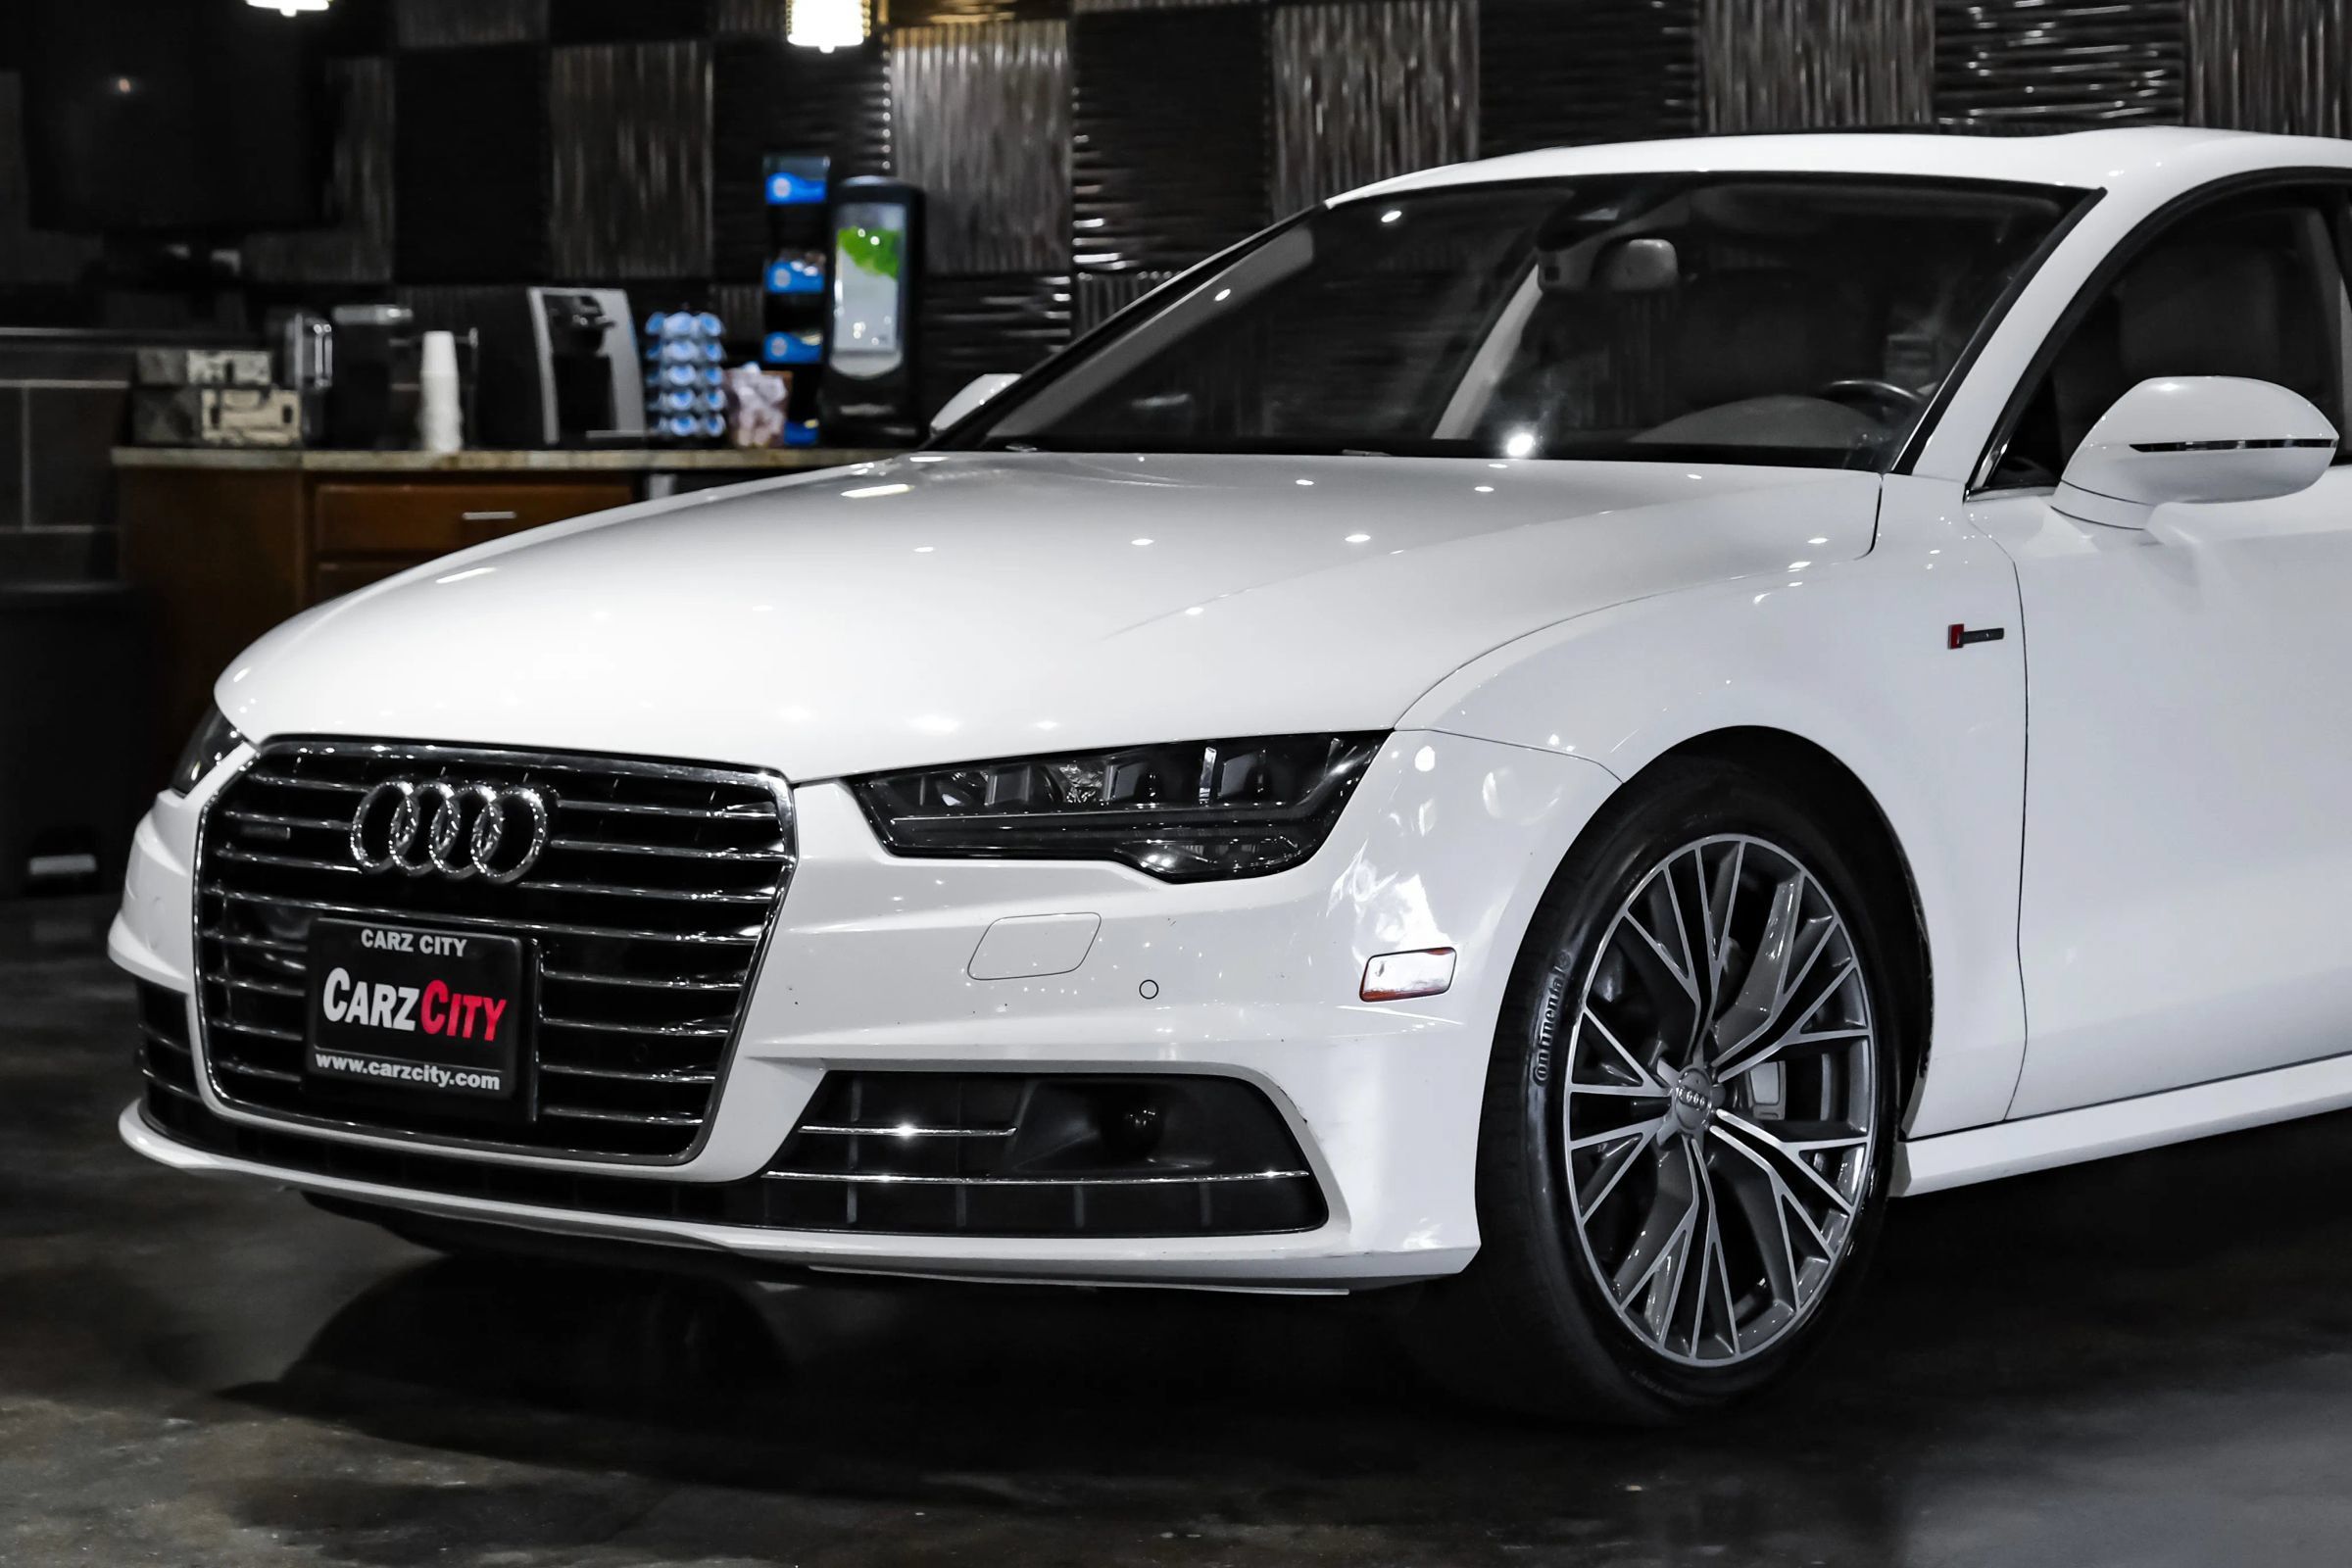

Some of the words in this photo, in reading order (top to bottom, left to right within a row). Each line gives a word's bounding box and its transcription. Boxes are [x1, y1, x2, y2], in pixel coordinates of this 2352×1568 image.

[361, 929, 414, 952] CARZ
[419, 935, 467, 956] CITY
[315, 1054, 500, 1090] www.carzcity.com
